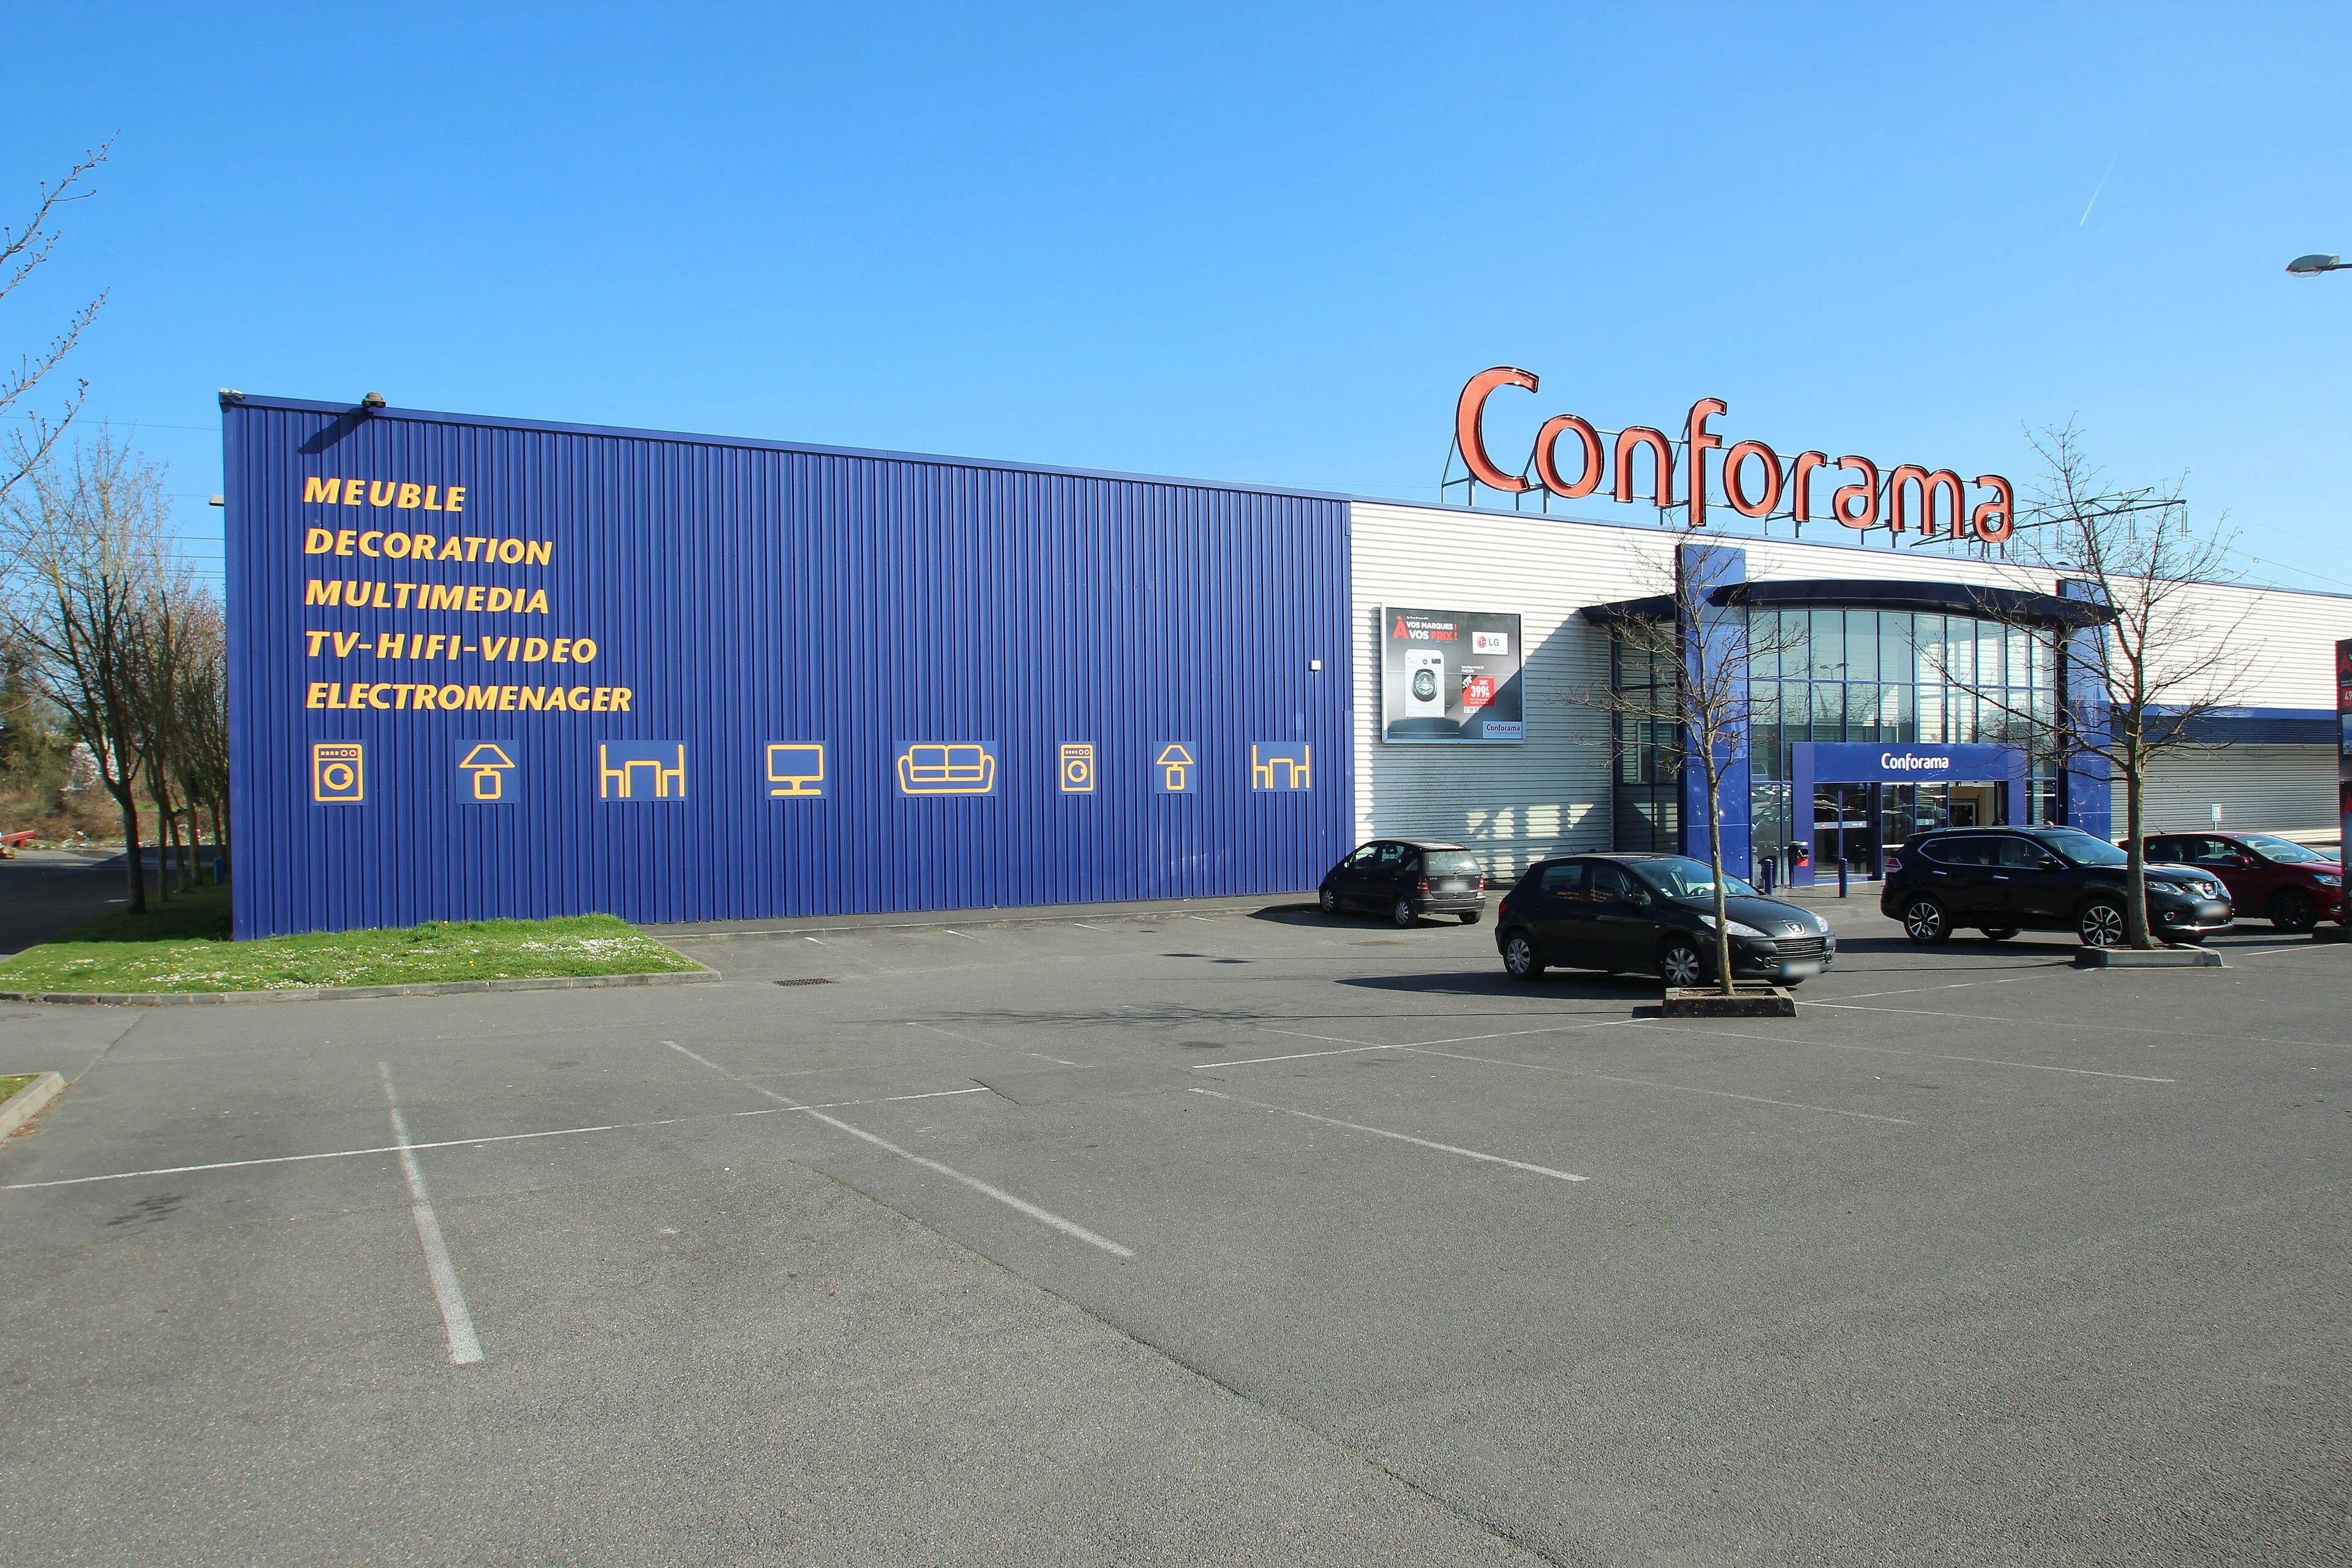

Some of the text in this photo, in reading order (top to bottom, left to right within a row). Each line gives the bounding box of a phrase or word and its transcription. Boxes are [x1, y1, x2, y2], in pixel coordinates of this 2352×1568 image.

[1457, 366, 2013, 543] Conforama
[304, 477, 466, 512] MEUBLE
[304, 528, 553, 565] DECORATION
[305, 579, 549, 614] MULTIMEDIA
[1392, 615, 1409, 639] À
[1409, 630, 1429, 639] VOS
[1431, 631, 1452, 641] PRIX
[306, 631, 598, 663] TV-HIFI-VIDEO
[306, 682, 632, 712] ELECTROMENAGER
[1881, 752, 1949, 771] Conforama
